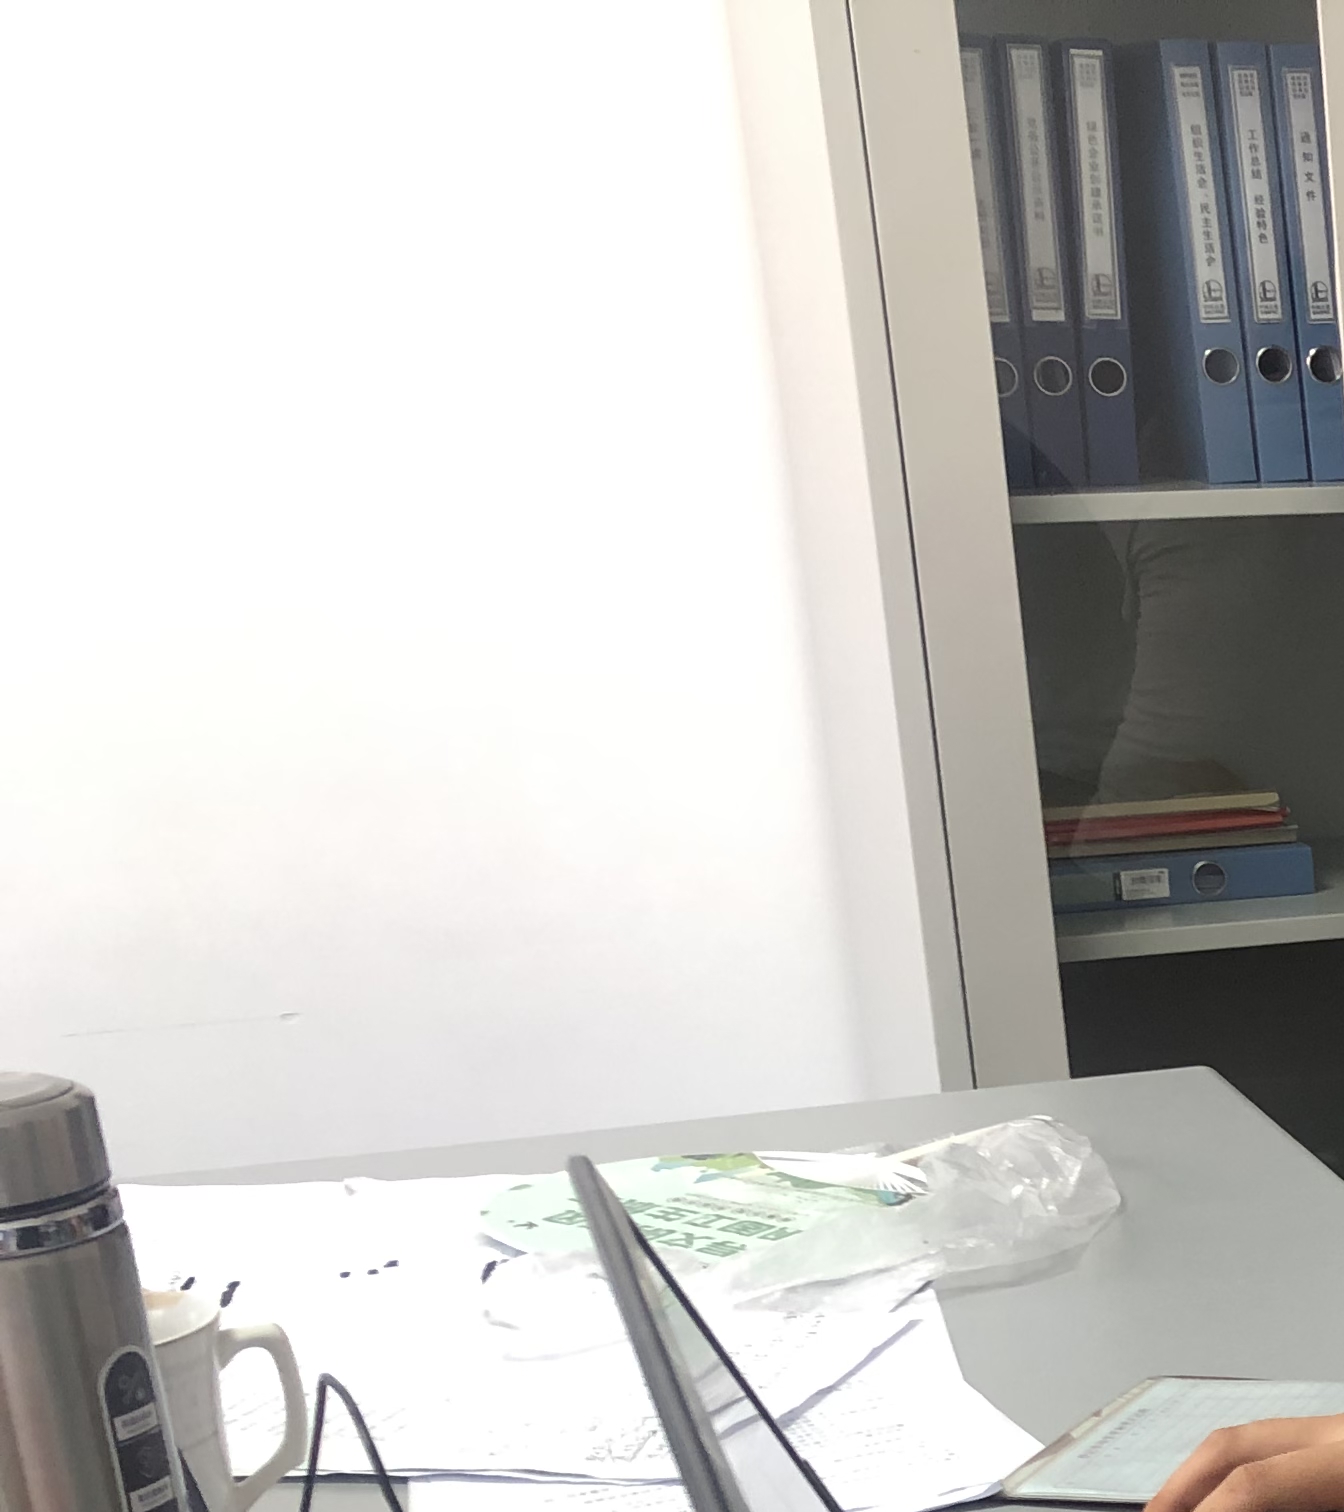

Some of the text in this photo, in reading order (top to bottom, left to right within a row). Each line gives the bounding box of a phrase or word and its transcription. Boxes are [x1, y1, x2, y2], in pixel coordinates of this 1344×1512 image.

[1247, 129, 1262, 180] 工作总结
[1299, 131, 1318, 202] 通知文件
